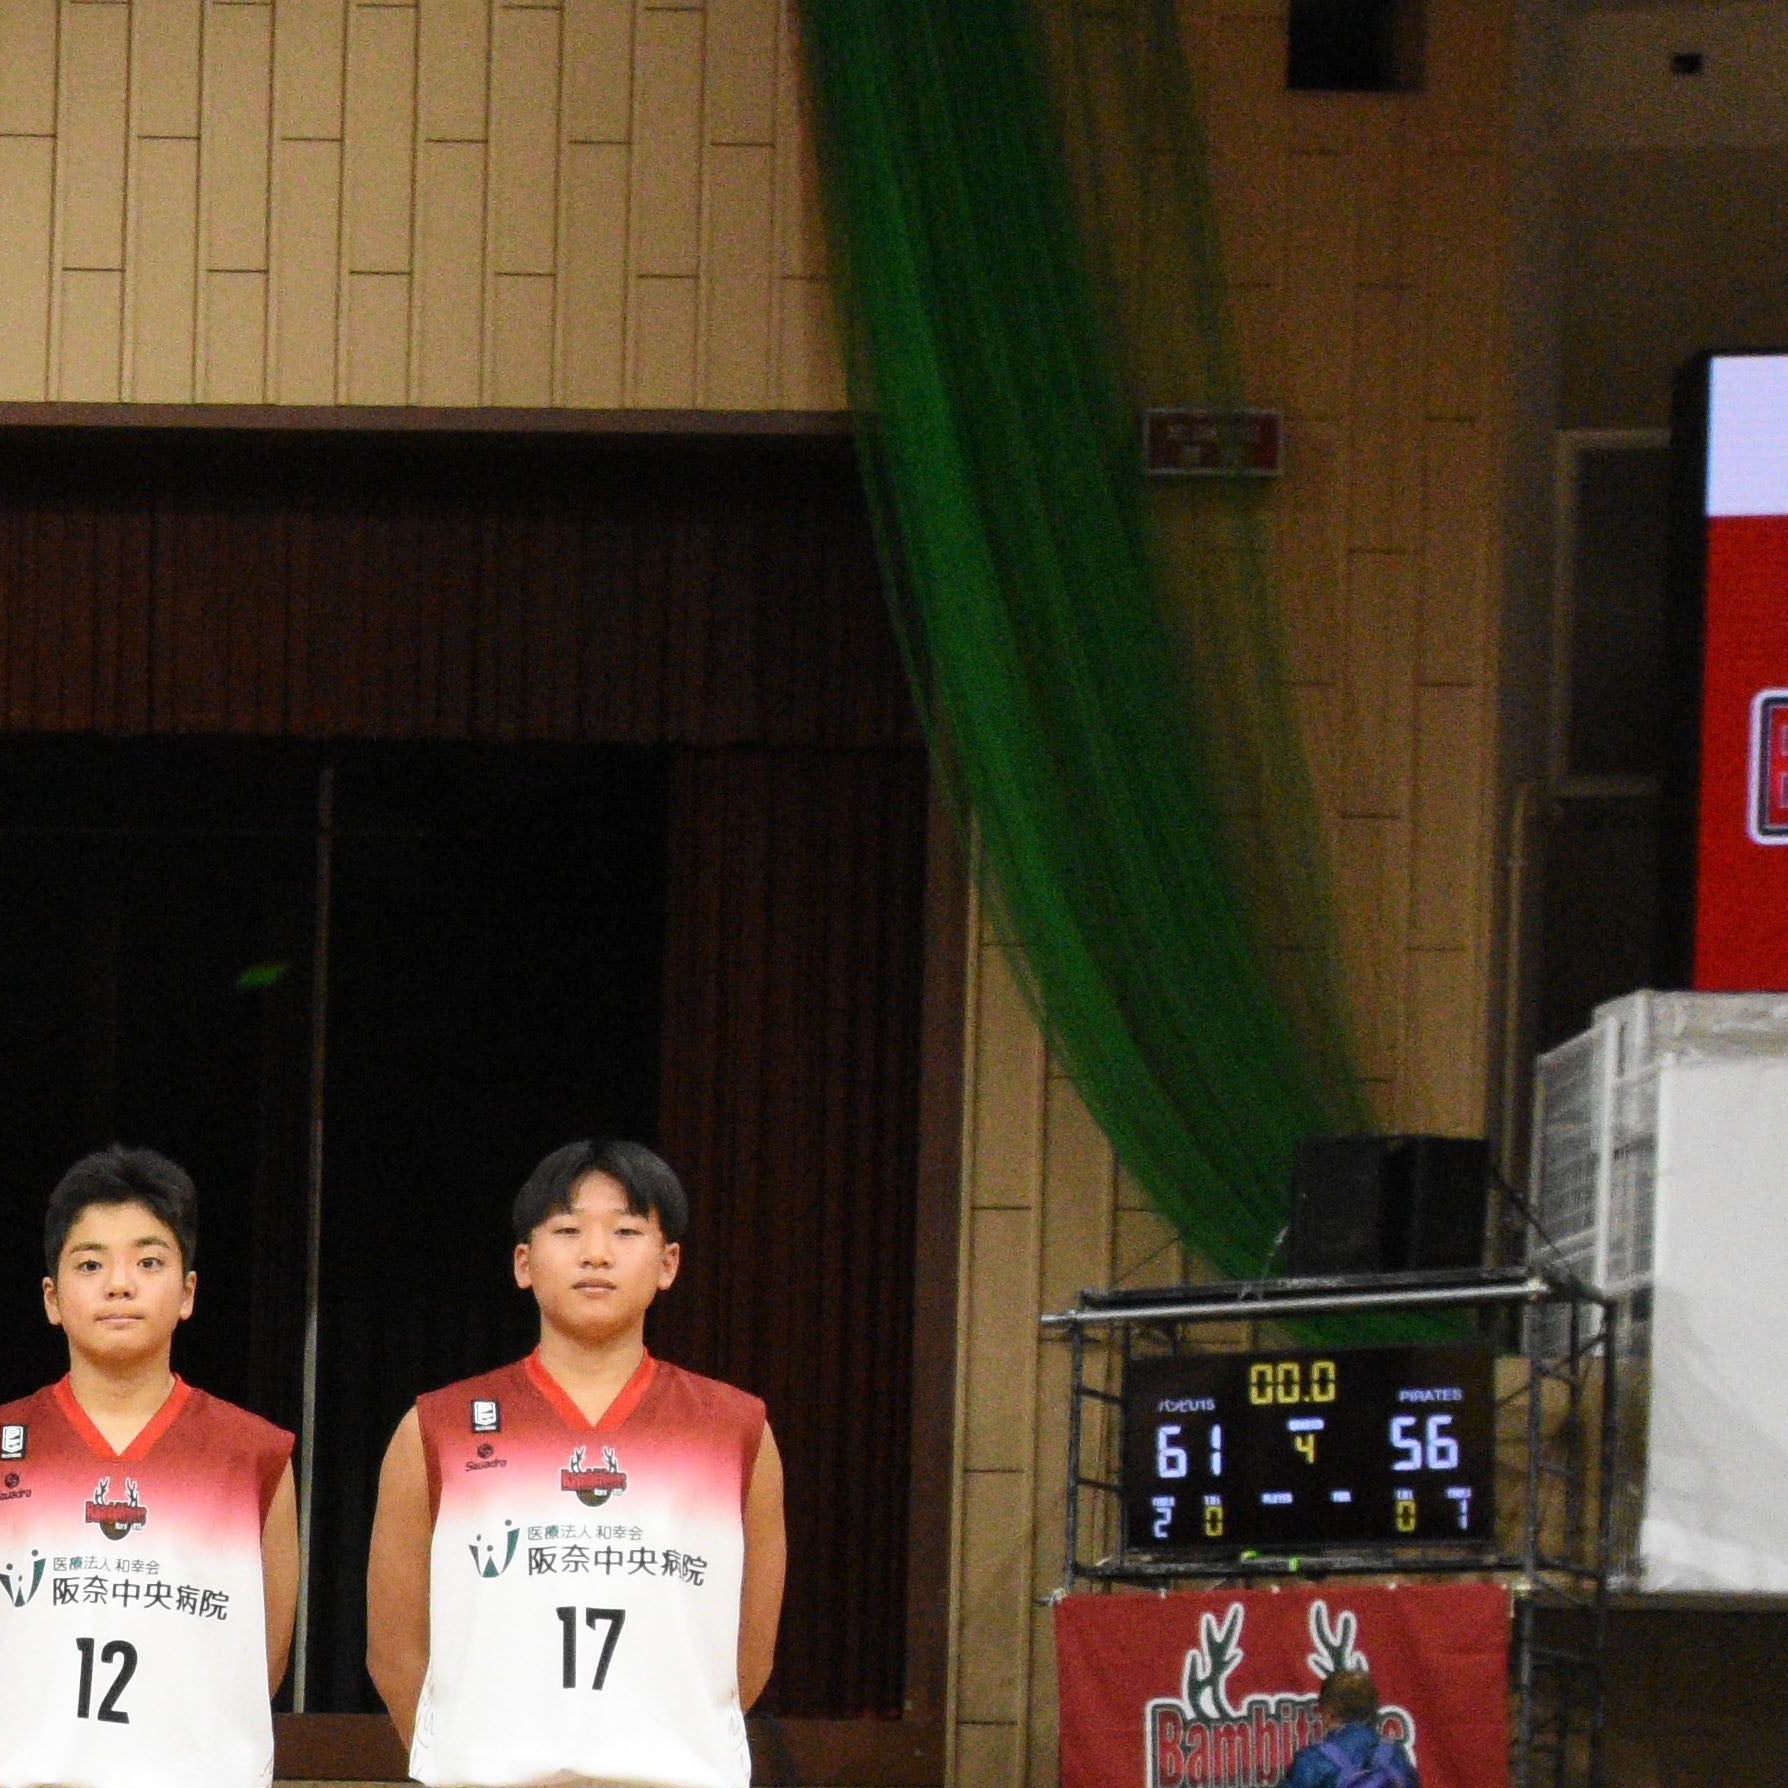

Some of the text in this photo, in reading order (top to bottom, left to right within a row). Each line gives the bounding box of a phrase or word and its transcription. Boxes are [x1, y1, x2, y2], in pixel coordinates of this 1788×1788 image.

[1249, 1360, 1336, 1405] 00.0
[1398, 1387, 1463, 1402] PIRATES
[1157, 1424, 1222, 1479] 61
[1294, 1432, 1315, 1464] 4
[1389, 1414, 1460, 1471] 56
[528, 1524, 591, 1541] 医療法人
[1152, 1506, 1173, 1539] 2
[1204, 1506, 1223, 1537] 0
[1396, 1500, 1416, 1532] 0
[53, 1556, 111, 1573] 医療法人
[528, 1544, 708, 1587] 阪奈中央病院
[52, 1575, 230, 1621] 阪奈中央病院
[555, 1606, 626, 1691] 17
[76, 1637, 138, 1724] 12
